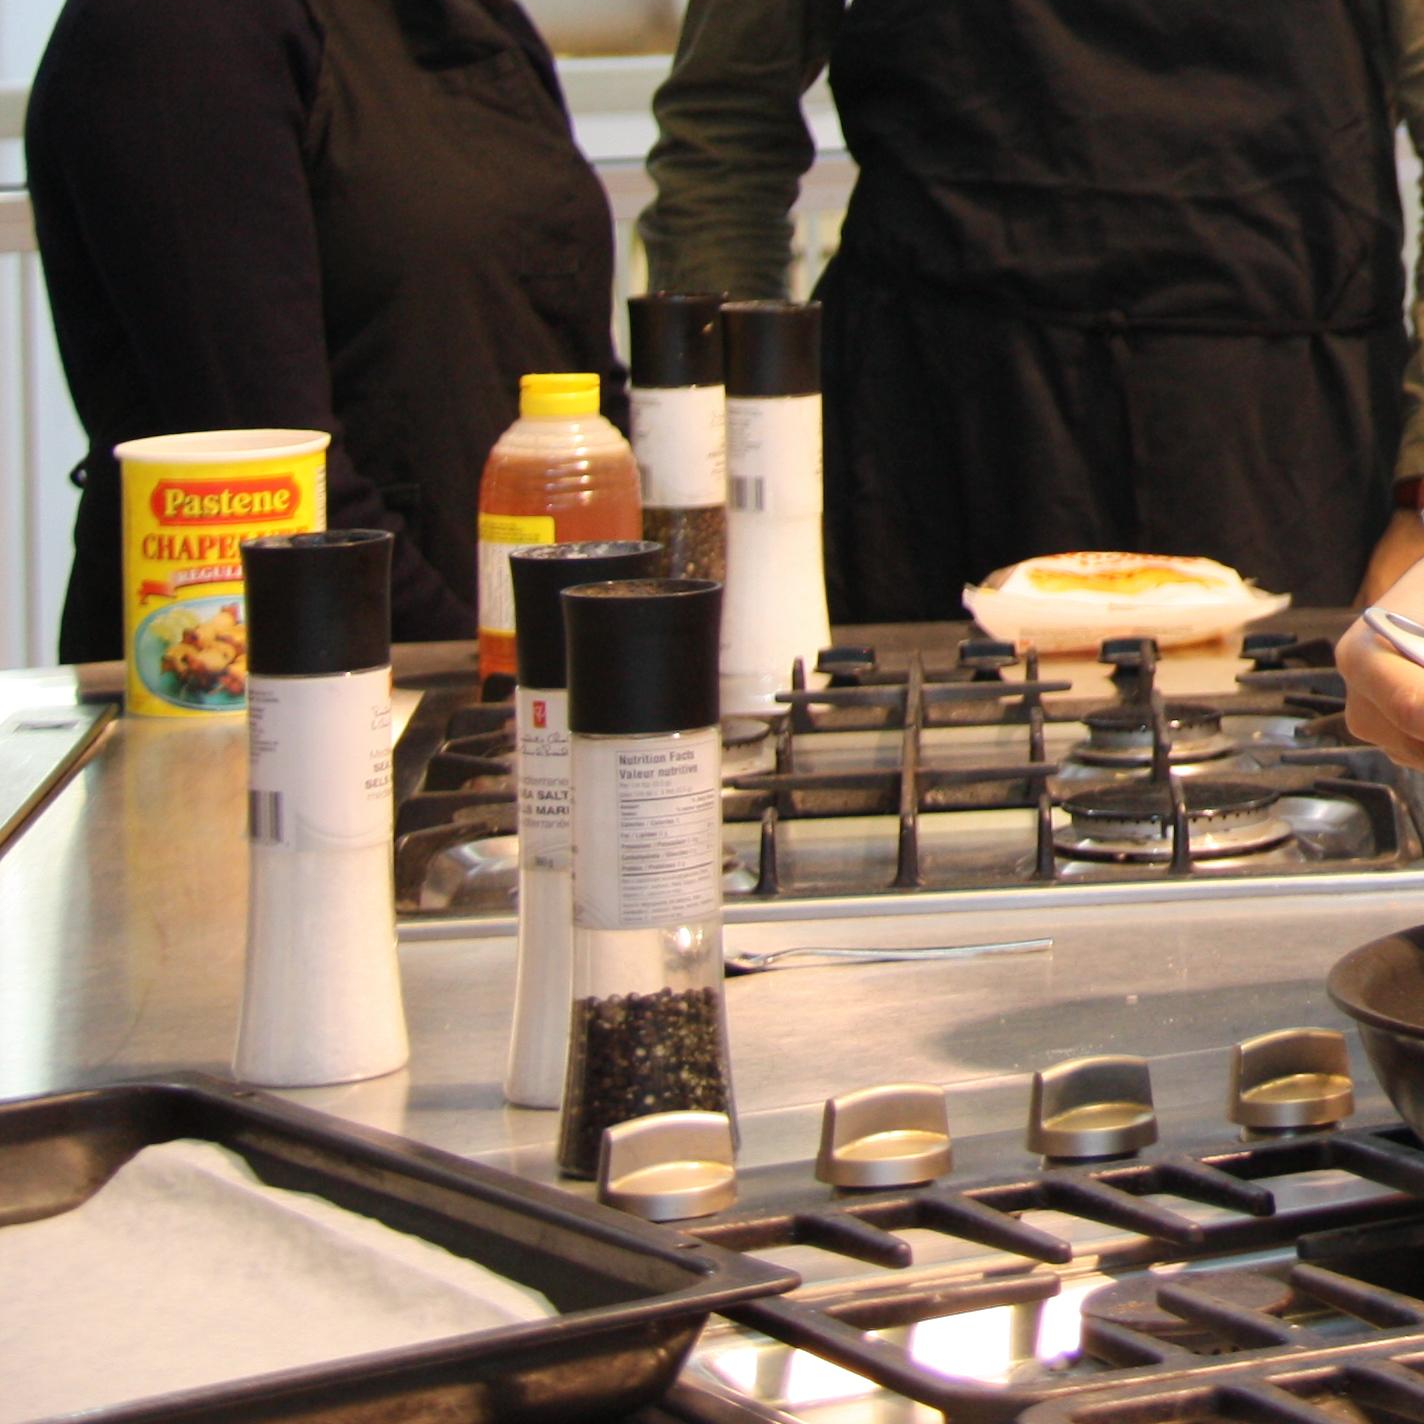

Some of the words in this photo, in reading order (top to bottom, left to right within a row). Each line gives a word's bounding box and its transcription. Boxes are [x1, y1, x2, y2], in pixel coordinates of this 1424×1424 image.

[163, 488, 290, 516] Pastene
[619, 753, 666, 766] Nutrition
[669, 750, 695, 762] Facts
[619, 768, 655, 780] Valeur
[658, 763, 698, 777] nutritive
[537, 789, 569, 801] SALT
